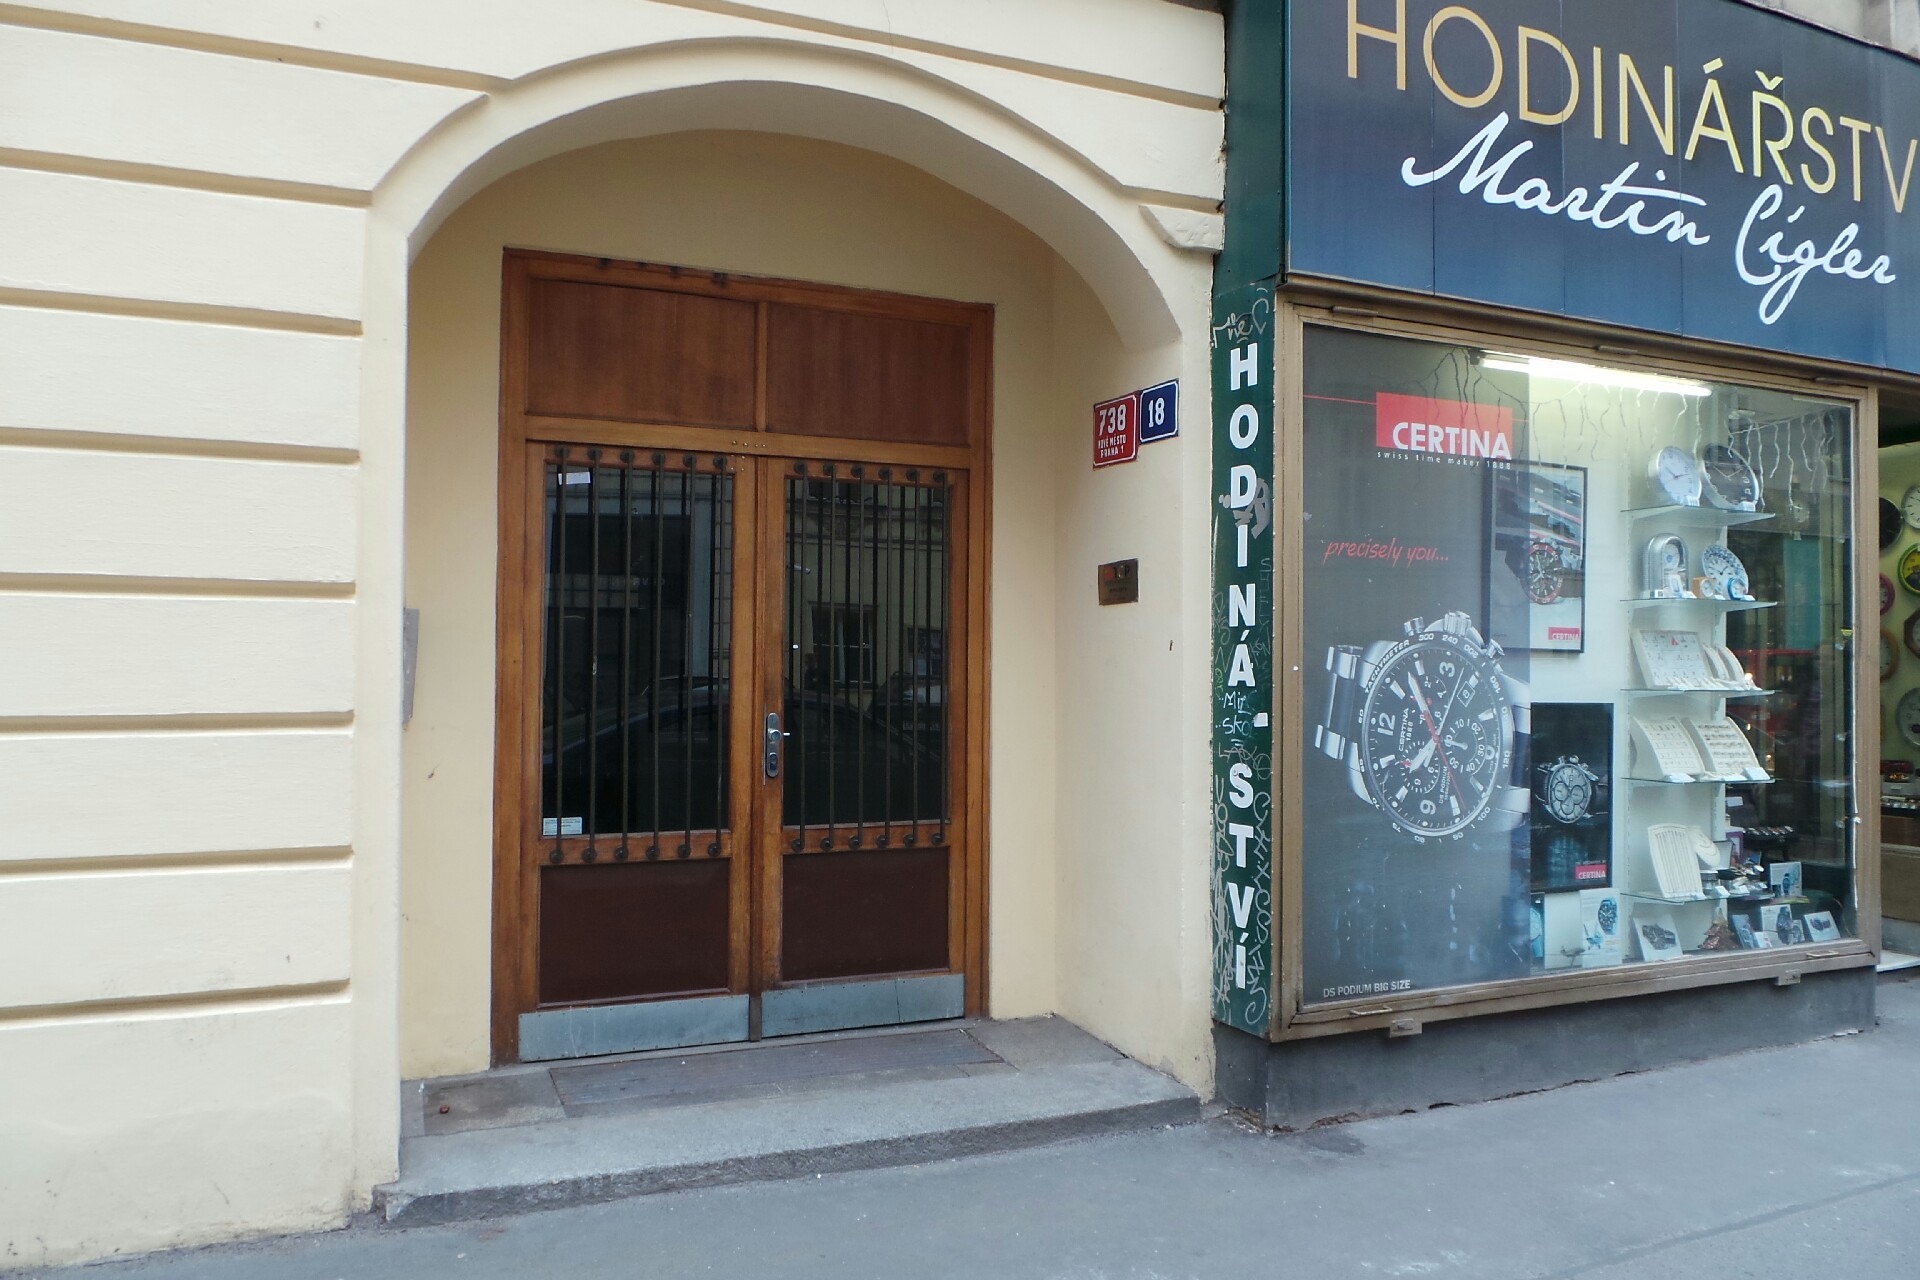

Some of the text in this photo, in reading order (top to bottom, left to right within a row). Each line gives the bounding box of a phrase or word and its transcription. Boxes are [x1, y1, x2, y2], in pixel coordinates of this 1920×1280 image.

[1401, 111, 1896, 325] Martin Cígler
[1099, 404, 1127, 436] 738
[1148, 397, 1165, 428] 18
[1120, 444, 1124, 454] 1
[1392, 422, 1512, 461] CERTINA
[1377, 451, 1511, 470] swiss time maker 1888
[1323, 537, 1403, 568] precisely
[1439, 661, 1456, 678] 3
[1377, 712, 1396, 736] 12
[1399, 708, 1410, 752] CERTINA
[1419, 799, 1437, 815] 9
[1578, 871, 1607, 880] CERTINA
[1323, 979, 1411, 998] DS PODIUM BIG SIZE
